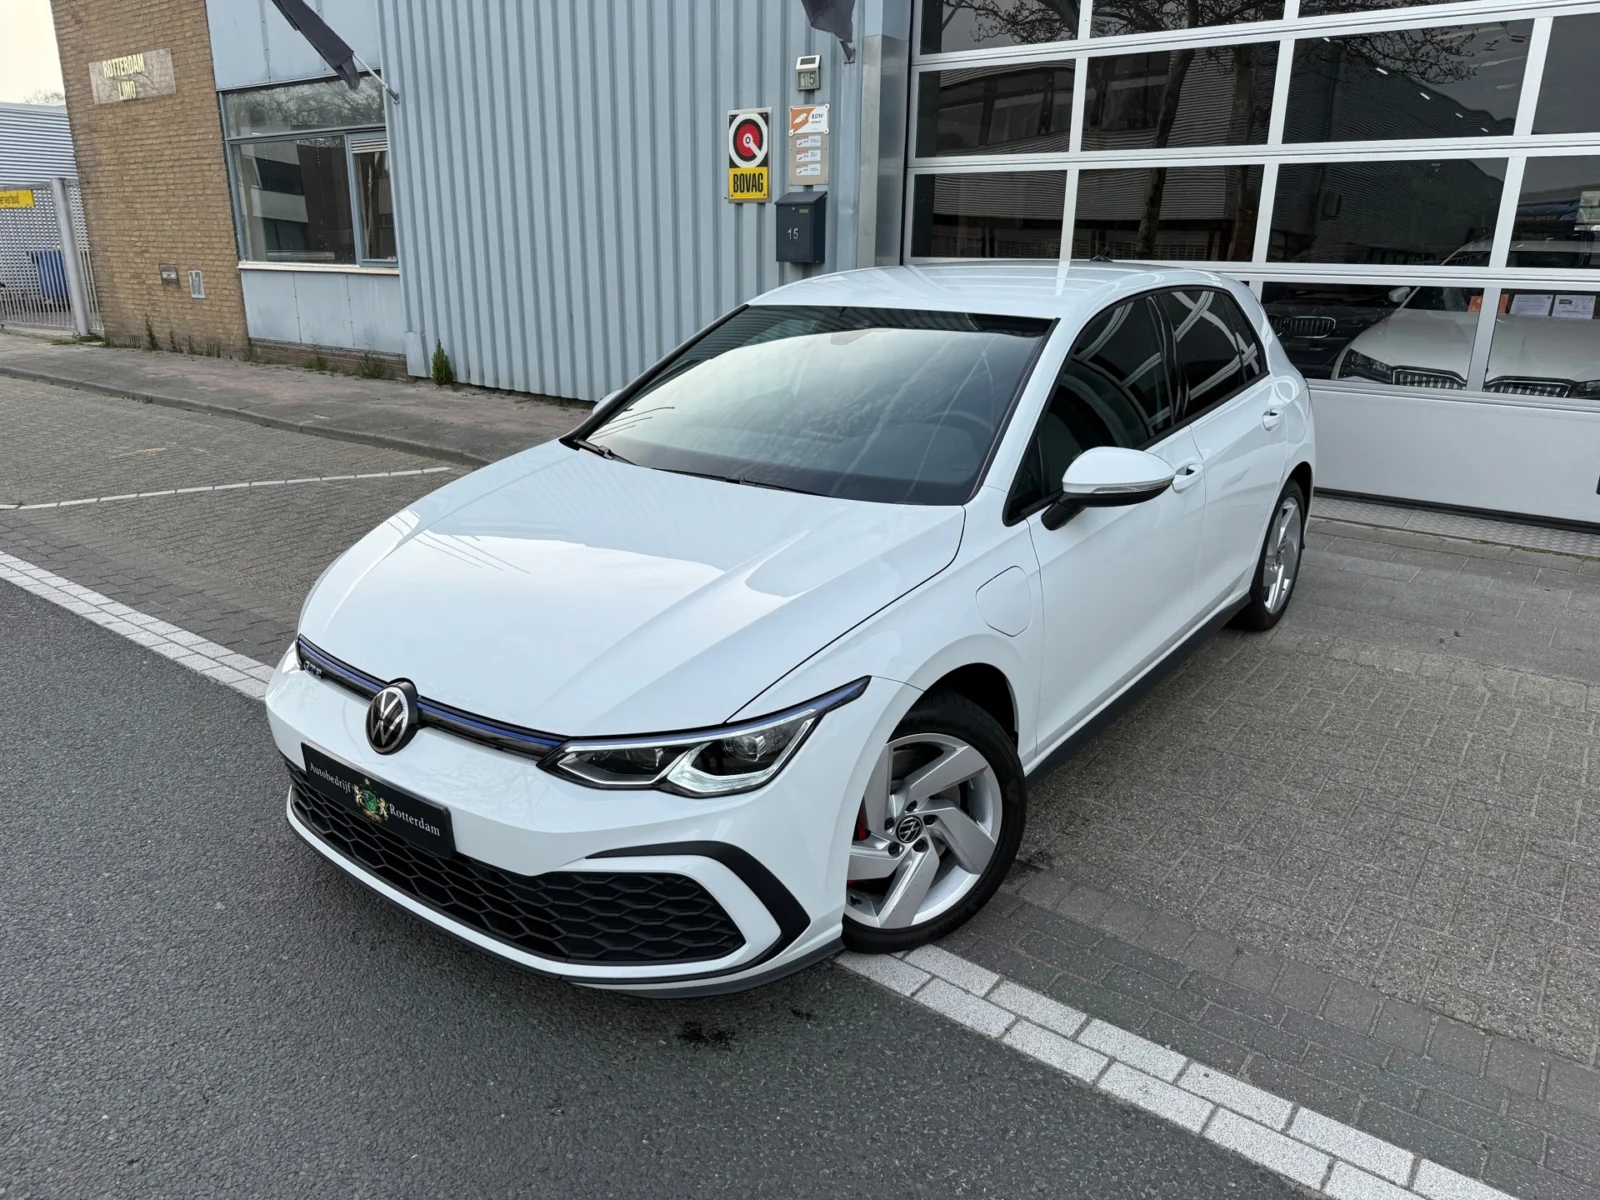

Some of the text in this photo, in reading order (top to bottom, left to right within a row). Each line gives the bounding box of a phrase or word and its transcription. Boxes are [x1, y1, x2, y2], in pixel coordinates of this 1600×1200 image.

[102, 53, 145, 79] ROTTERDAM
[801, 73, 815, 86] 15
[118, 81, 137, 100] LIMO
[733, 173, 764, 193] BOVAG
[787, 228, 799, 240] 15
[310, 762, 441, 836] Autobedrijf Rotterdam
